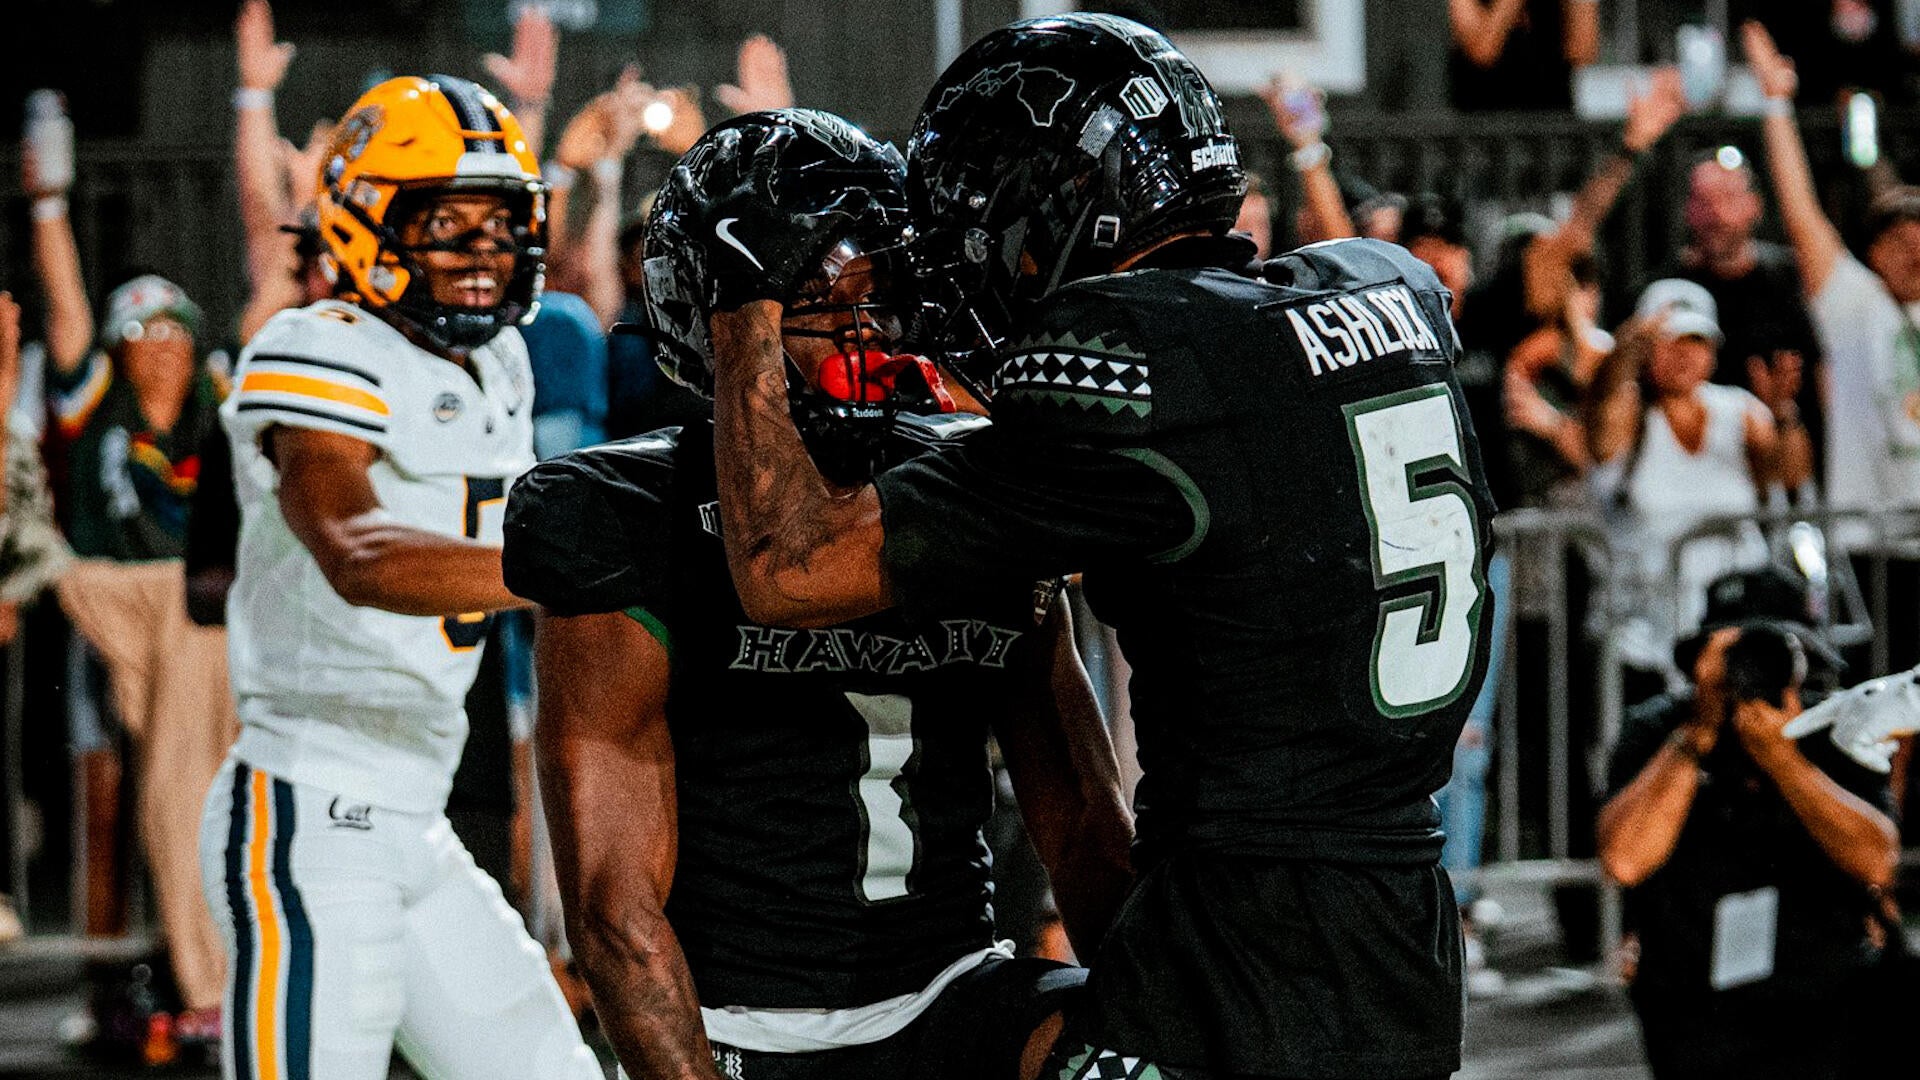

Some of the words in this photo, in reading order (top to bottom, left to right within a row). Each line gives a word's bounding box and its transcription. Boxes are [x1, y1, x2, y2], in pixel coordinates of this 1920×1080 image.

[1285, 287, 1440, 377] ASHLOCK
[1342, 383, 1485, 718] 5
[844, 691, 915, 902] 1
